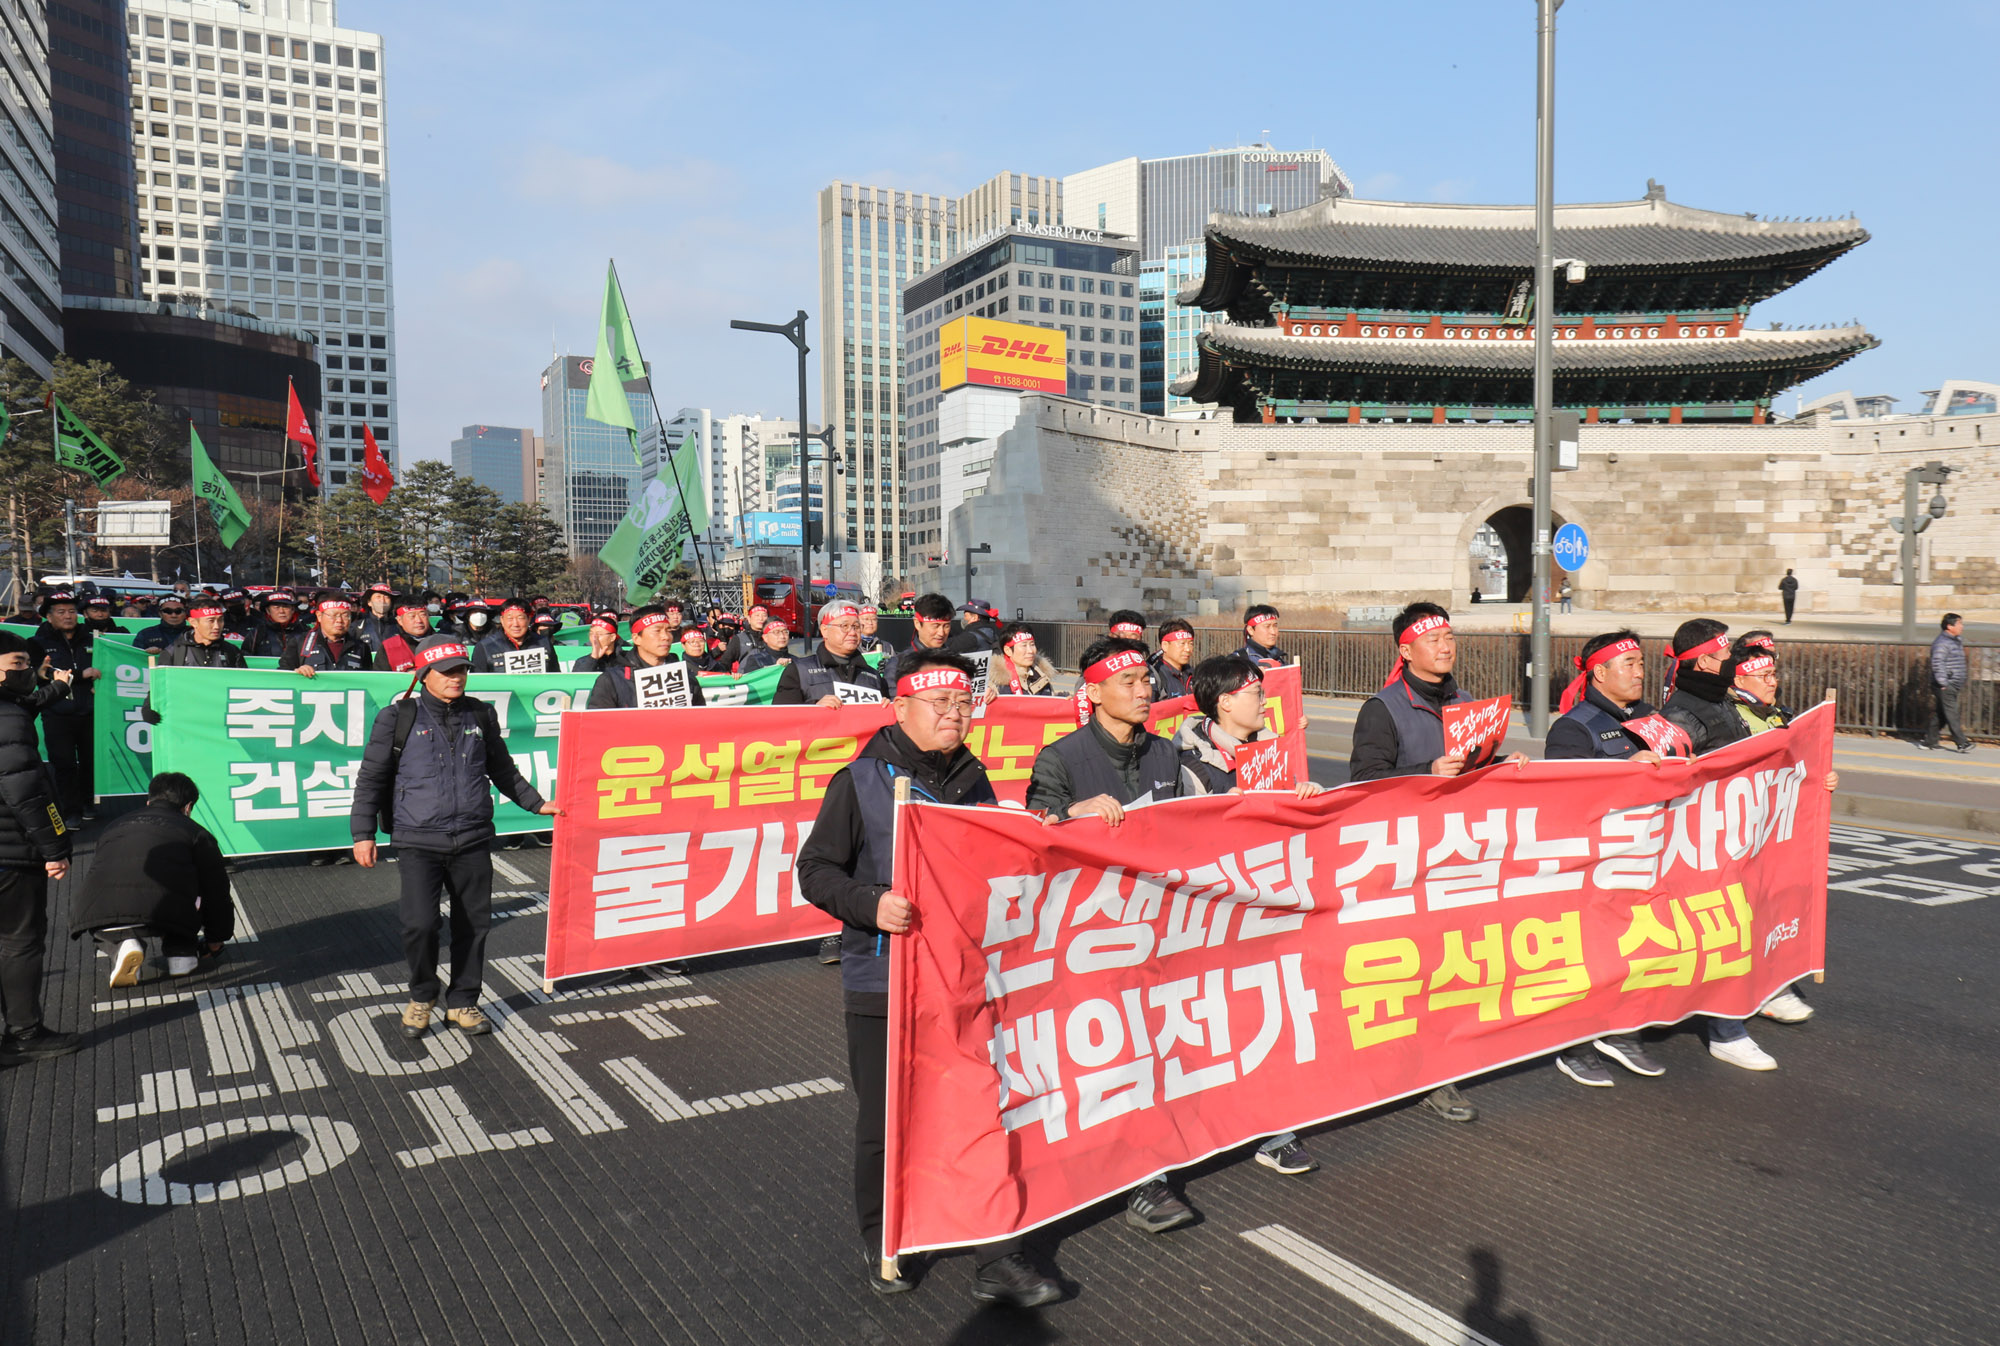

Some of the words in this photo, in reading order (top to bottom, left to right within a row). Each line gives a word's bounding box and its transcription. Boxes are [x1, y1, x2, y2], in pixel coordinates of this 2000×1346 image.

[1242, 153, 1321, 163] COURTYARD
[944, 342, 962, 358] DHL
[981, 335, 1053, 363] DHL
[1003, 376, 1041, 389] 1588-0001
[1412, 617, 1436, 636] 단결
[424, 647, 444, 663] 단결
[509, 653, 541, 671] 건설
[1105, 653, 1134, 672] 단결
[1742, 657, 1762, 673] 단결
[640, 669, 686, 698] 건설
[911, 671, 939, 691] 단결
[226, 688, 364, 748] 죽지
[597, 736, 857, 819] 윤석열은
[592, 821, 817, 940] 물가
[981, 832, 1316, 1002] 민생파탄
[1336, 760, 1807, 924] 건설노동자에게
[988, 953, 1318, 1144] 책임전가
[1340, 911, 1591, 1050] 윤석열
[1618, 882, 1755, 993] 심판
